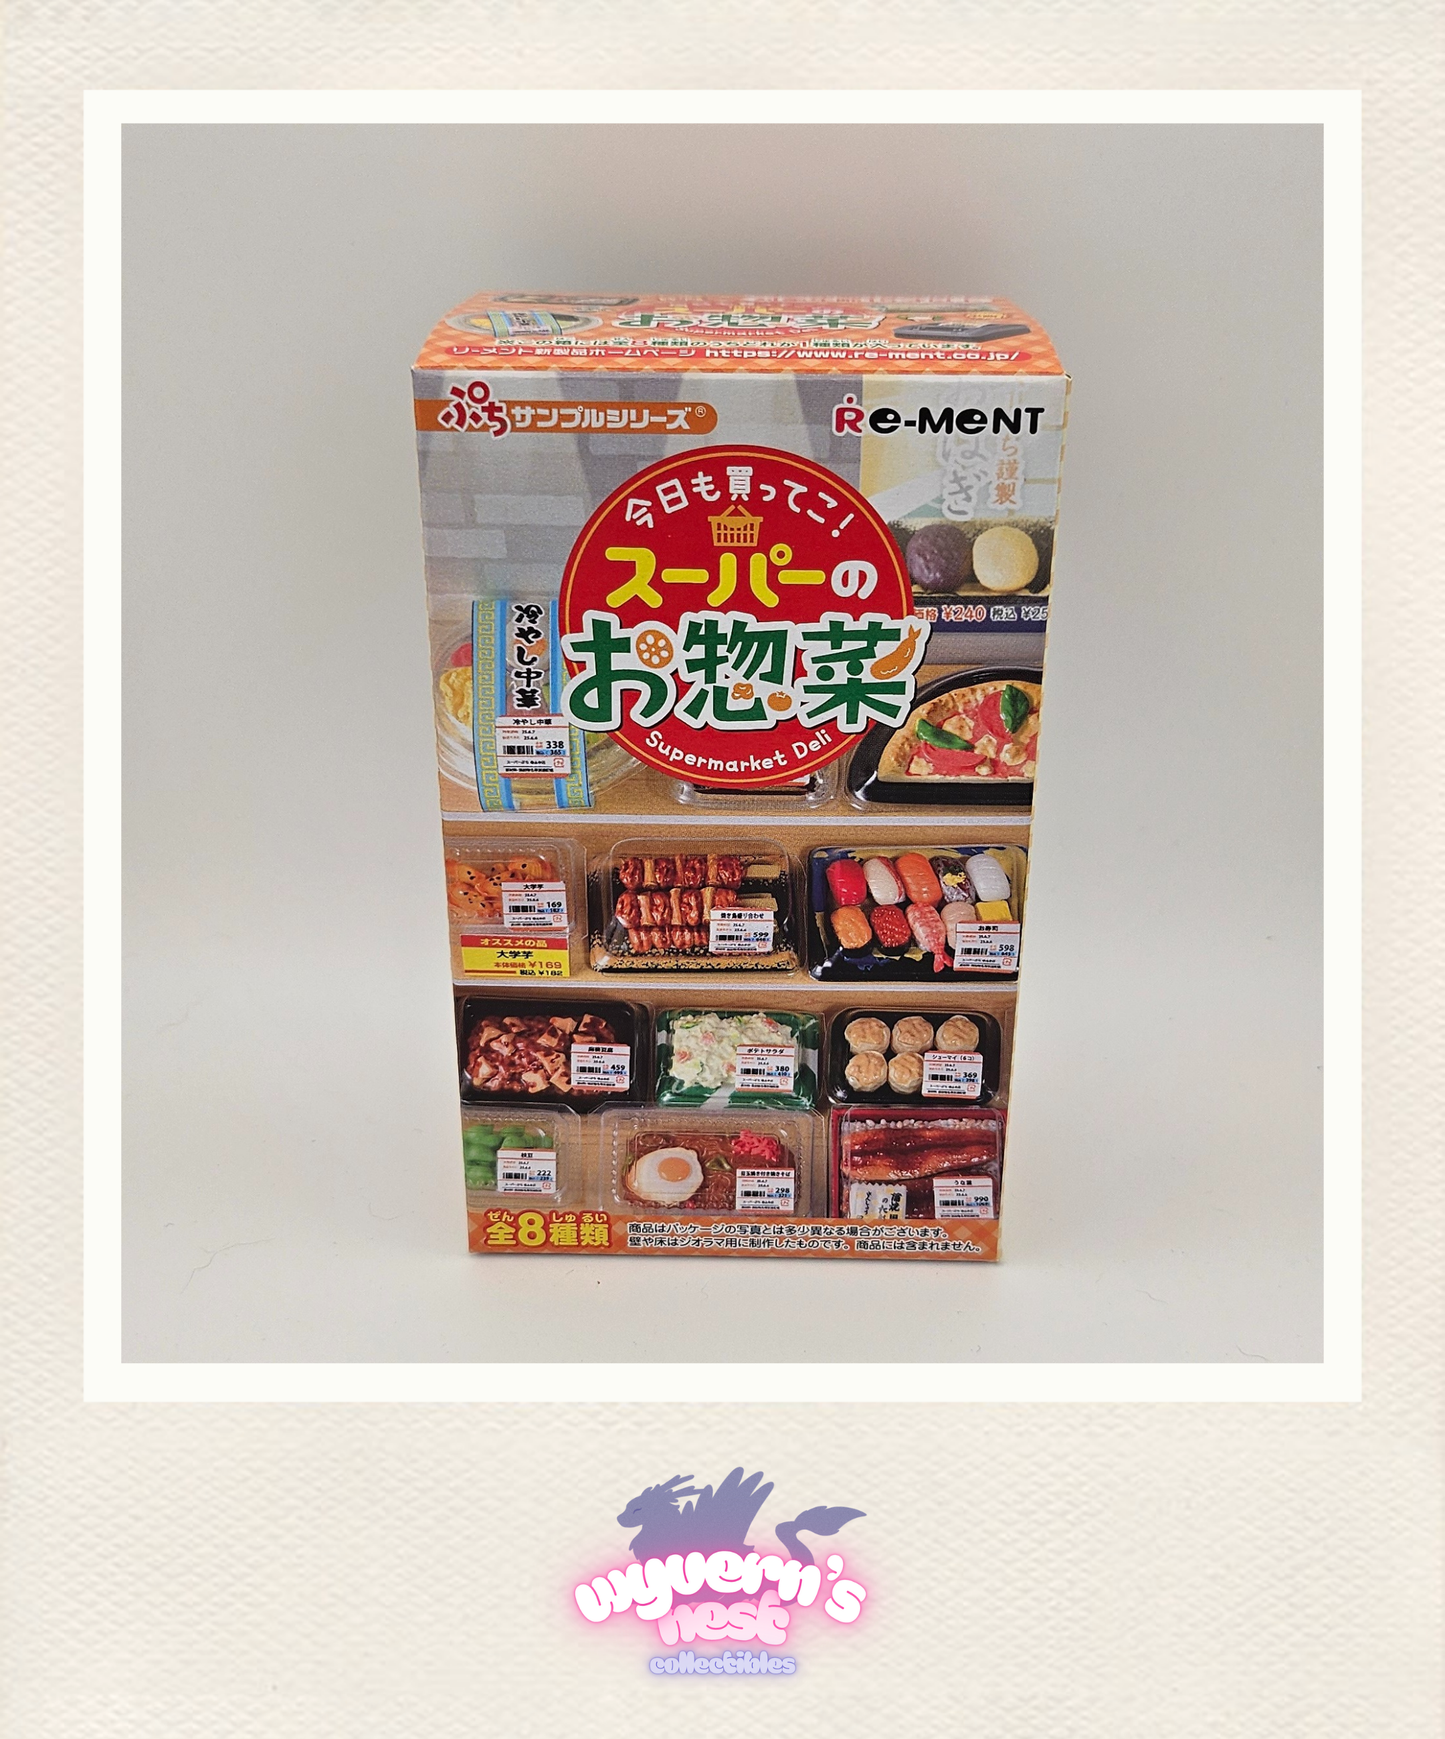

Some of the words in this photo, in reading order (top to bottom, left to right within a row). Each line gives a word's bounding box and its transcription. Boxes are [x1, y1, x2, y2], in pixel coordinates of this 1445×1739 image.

[605, 543, 879, 610] スーパーの
[565, 617, 912, 728] お惣菜
[545, 740, 565, 750] 338
[645, 730, 788, 773] Supermarket
[791, 728, 834, 759] Deli
[480, 937, 548, 948] オススメの品
[998, 944, 1015, 952] 598
[496, 949, 534, 960] 大学芋
[528, 961, 563, 969] ¥169
[536, 1169, 552, 1177] 222
[488, 1210, 514, 1222] ぜん
[487, 1211, 609, 1246] 全8種類
[628, 1223, 949, 1238] 商品はパッケージの写真とは多少異なる場合がございます。
[628, 1236, 850, 1250] 壁や床はジオラマ用に制作したものです。
[856, 1240, 982, 1252] 商品には含まれません。
